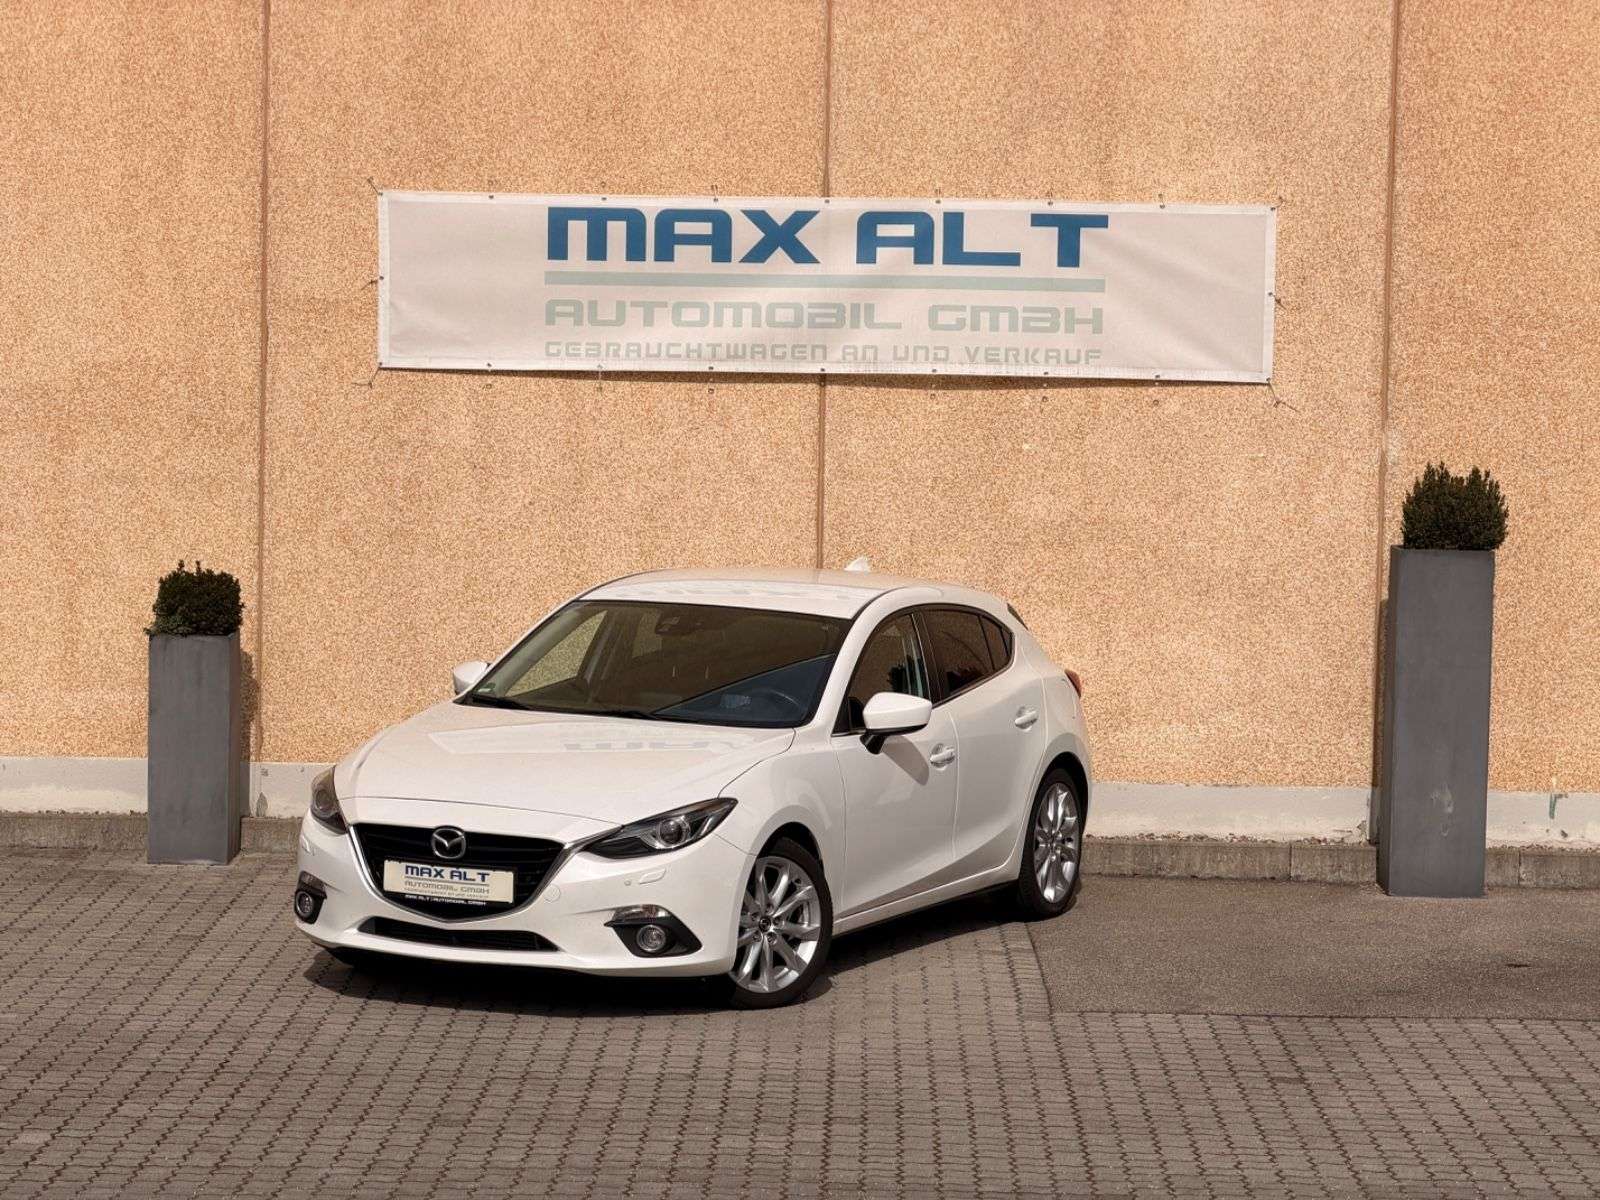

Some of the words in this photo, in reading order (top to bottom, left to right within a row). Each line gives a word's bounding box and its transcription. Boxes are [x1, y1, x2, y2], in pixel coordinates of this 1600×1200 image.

[547, 206, 821, 264] MAX
[856, 210, 1109, 267] ALT
[545, 298, 902, 331] AUTOMOBIL
[545, 341, 828, 361] GEBRAUCHTWAGEN
[841, 344, 879, 361] AN
[893, 345, 950, 362] UND
[964, 346, 1102, 365] VERKAUF
[405, 864, 445, 878] MAX
[450, 869, 490, 882] ALT
